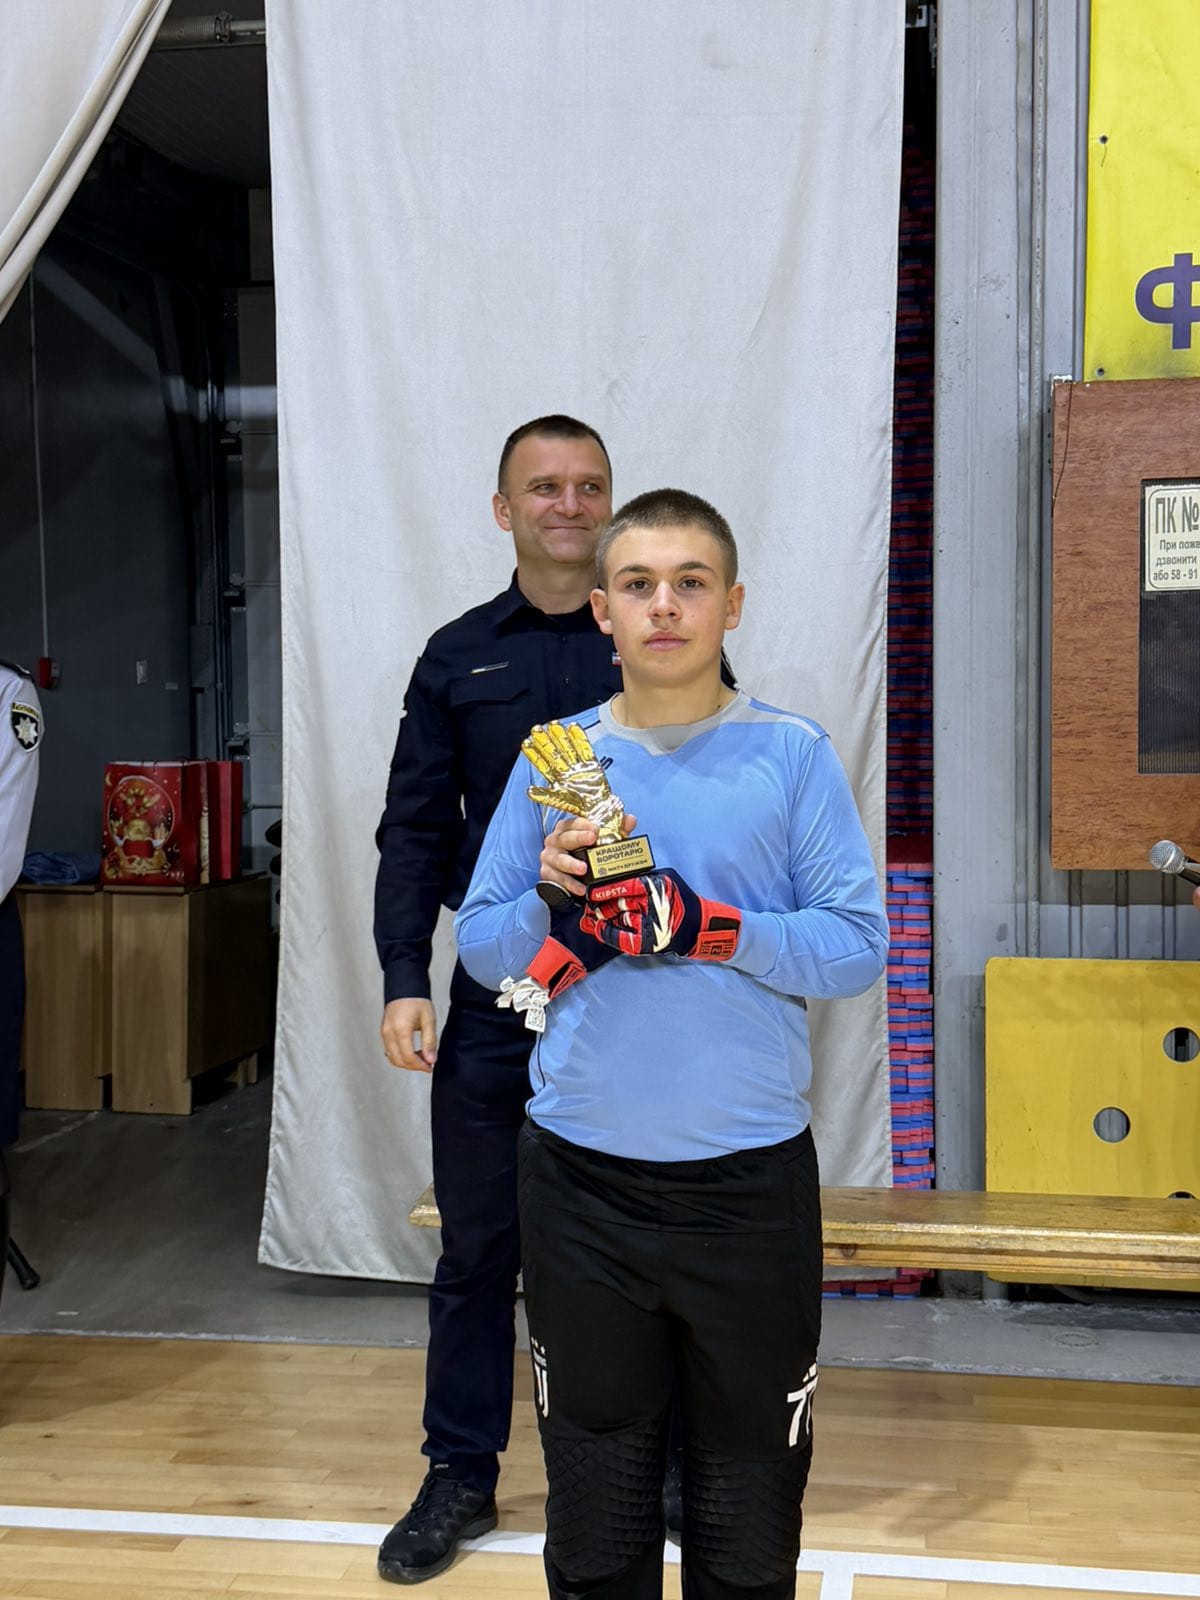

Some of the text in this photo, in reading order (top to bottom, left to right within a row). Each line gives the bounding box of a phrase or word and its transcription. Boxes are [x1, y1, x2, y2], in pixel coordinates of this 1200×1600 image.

[1135, 252, 1200, 350] Ф
[1155, 496, 1199, 534] ПК №
[1160, 540, 1177, 552] При
[1156, 556, 1197, 567] дзвонити
[1153, 570, 1169, 580] або
[1171, 570, 1181, 580] 58
[1188, 569, 1198, 579] 91
[596, 841, 640, 856] КРАЩОМУ
[597, 848, 643, 864] ВОРОТАРЮ
[595, 887, 627, 898] KIPSTA
